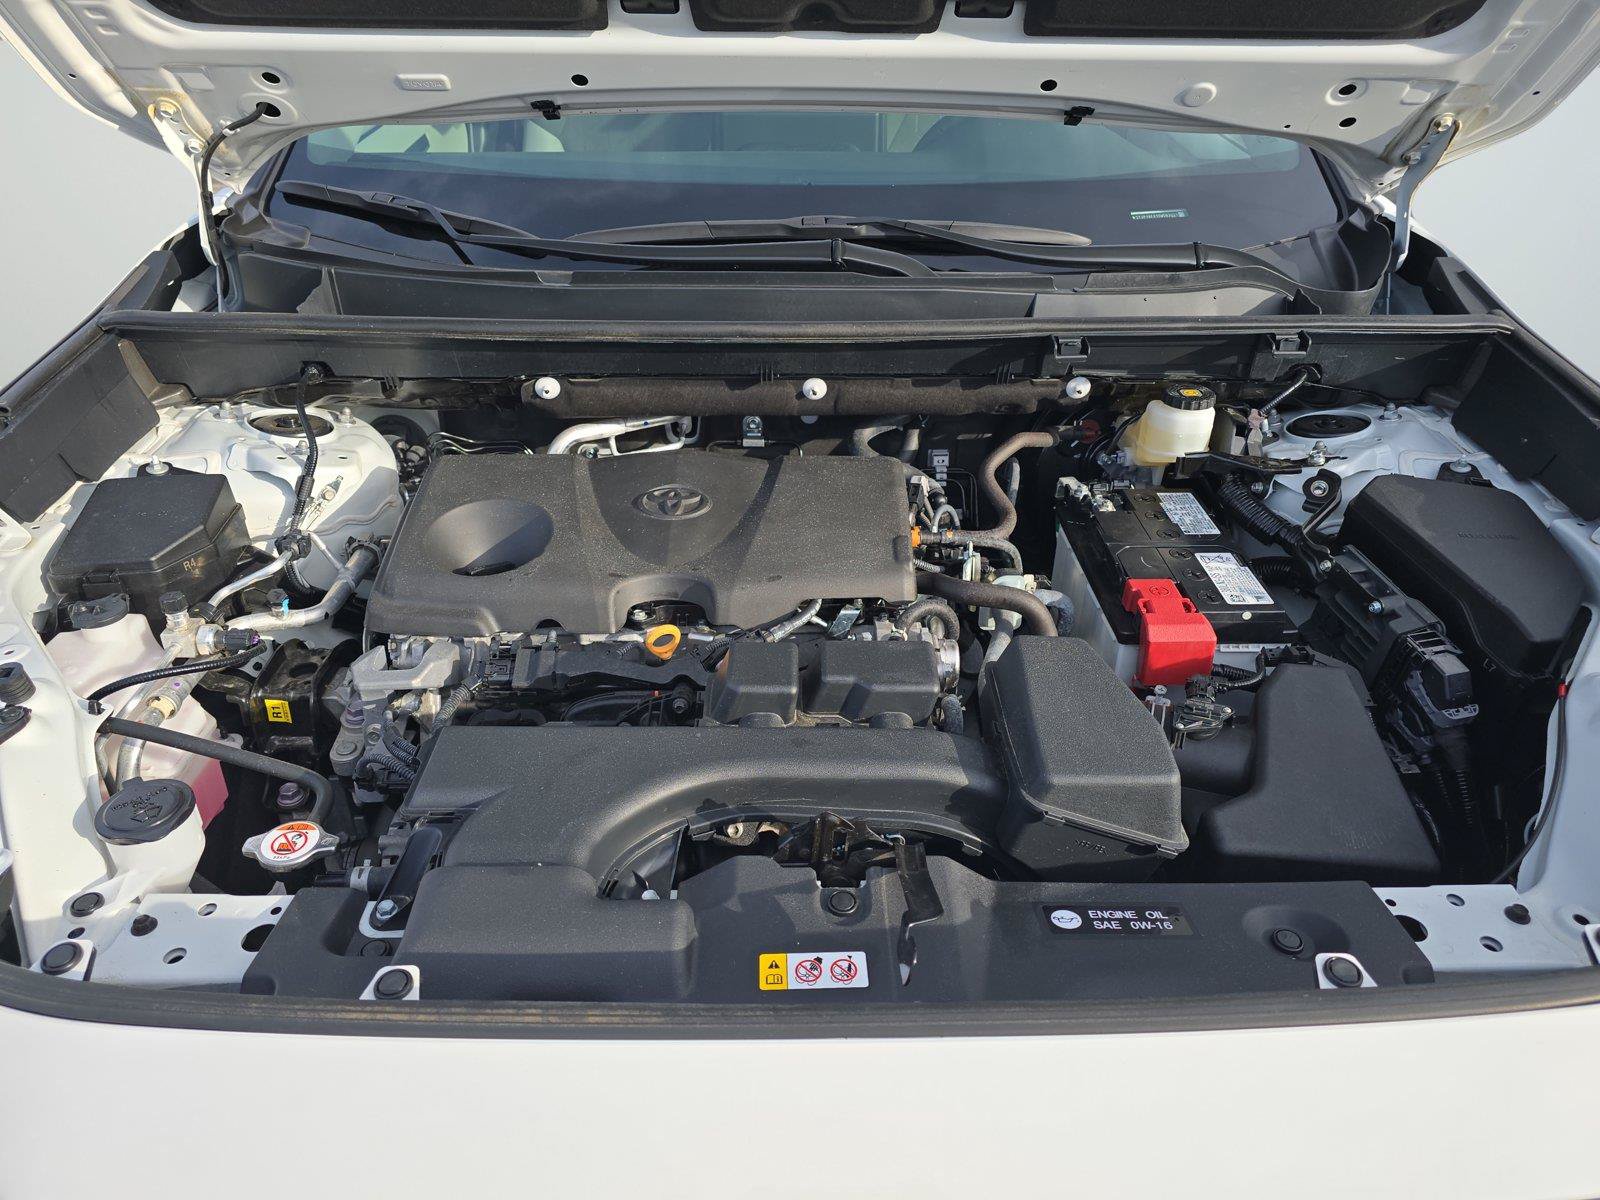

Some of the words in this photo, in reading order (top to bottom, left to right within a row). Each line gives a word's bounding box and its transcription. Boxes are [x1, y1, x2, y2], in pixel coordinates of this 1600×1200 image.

[271, 705, 283, 719] R1
[1087, 910, 1138, 919] ENGINE
[1145, 910, 1169, 919] OIL
[1093, 920, 1122, 930] SAE
[1130, 920, 1174, 930] 0W-16
